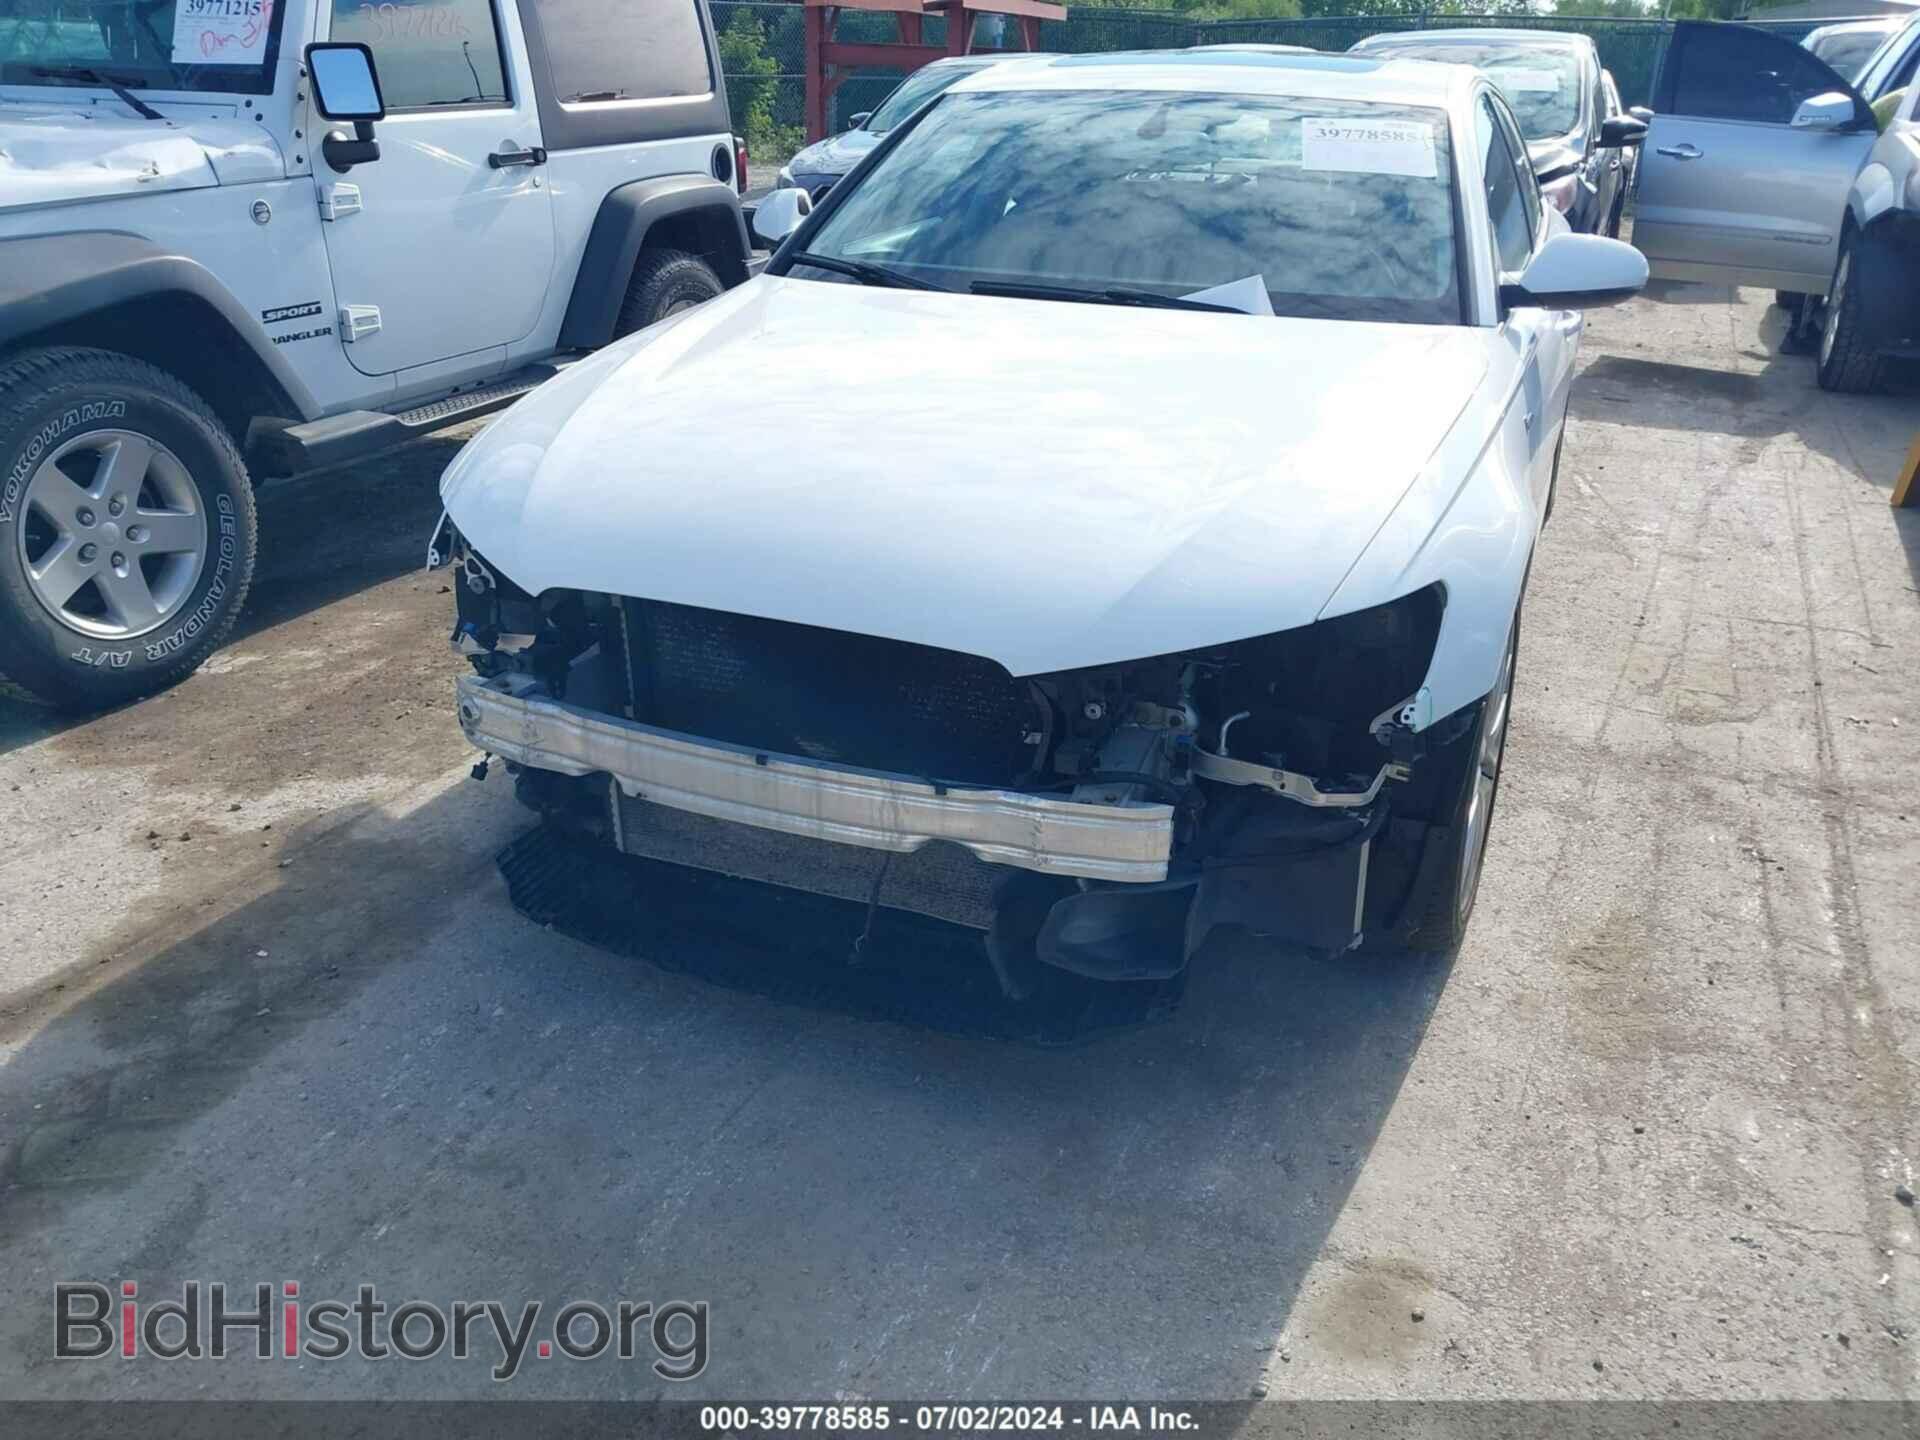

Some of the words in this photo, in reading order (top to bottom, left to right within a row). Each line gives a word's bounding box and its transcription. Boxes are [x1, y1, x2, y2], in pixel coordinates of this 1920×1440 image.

[185, 0, 261, 16] 39771215
[1313, 127, 1417, 142] 39778585
[264, 303, 320, 321] SPORT
[272, 327, 333, 344] ANGLER
[0, 400, 126, 523] YOKOHAMA
[145, 494, 237, 660] GEOLANDAR
[71, 647, 132, 667] A/T
